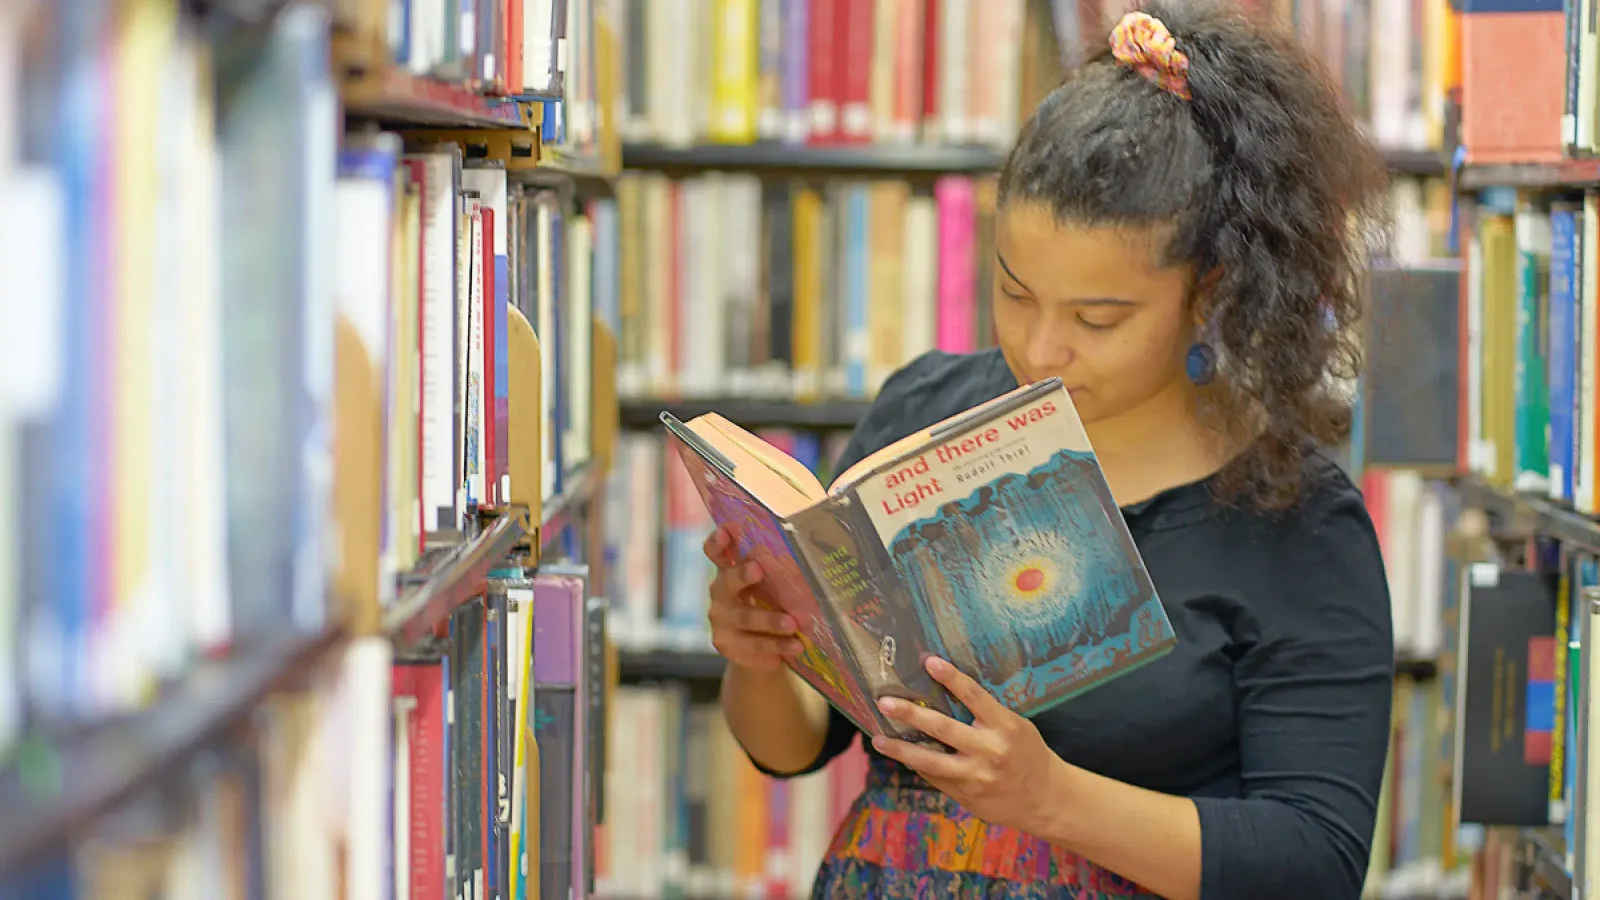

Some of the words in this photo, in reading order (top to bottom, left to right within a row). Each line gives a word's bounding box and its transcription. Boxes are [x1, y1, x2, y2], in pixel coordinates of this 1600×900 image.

[884, 454, 932, 490] and
[935, 427, 1000, 465] there
[1006, 400, 1057, 432] was
[881, 477, 943, 516] Light
